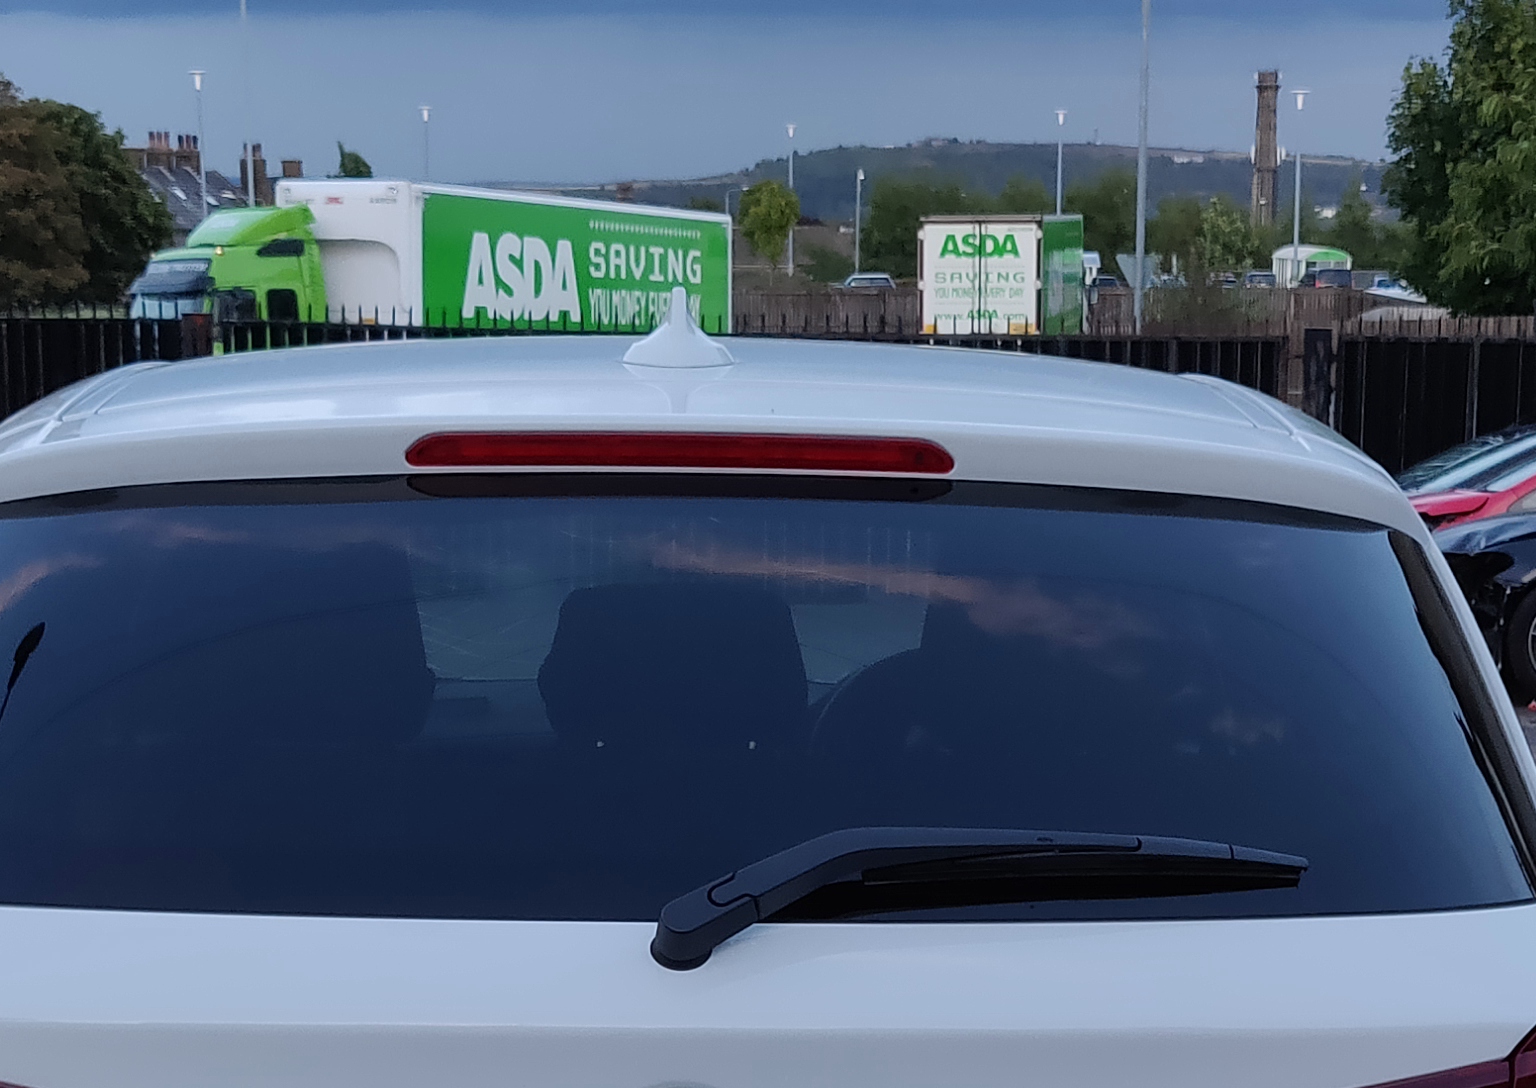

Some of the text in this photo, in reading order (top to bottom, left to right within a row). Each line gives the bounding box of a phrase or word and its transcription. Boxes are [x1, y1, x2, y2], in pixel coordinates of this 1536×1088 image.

[589, 241, 702, 284] SAVING
[939, 233, 1020, 259] ASDA
[462, 232, 582, 323] ASDA
[934, 272, 1026, 284] SAVING
[934, 287, 950, 299] YOU
[1009, 287, 1024, 299] DAY
[589, 287, 610, 326] YOU
[612, 289, 647, 327] MONEY
[649, 291, 673, 327] EVER
